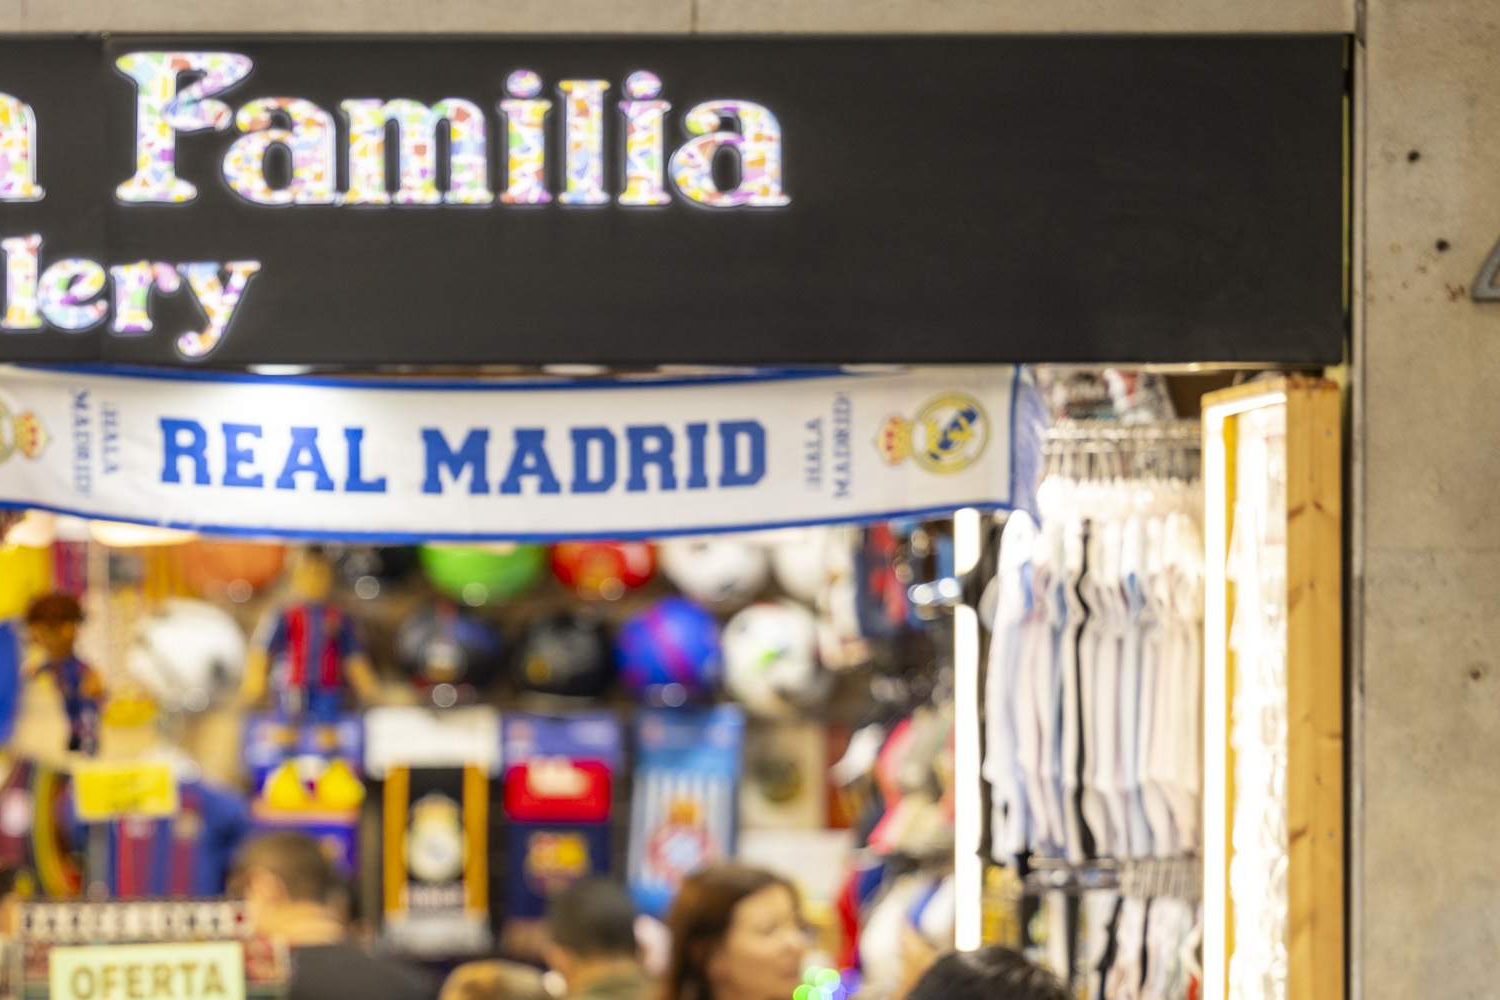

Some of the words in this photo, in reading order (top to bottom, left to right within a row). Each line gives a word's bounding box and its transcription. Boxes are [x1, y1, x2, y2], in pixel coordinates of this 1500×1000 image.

[115, 50, 790, 208] Familia
[158, 417, 387, 493] REAL
[421, 420, 767, 494] MADRID
[69, 960, 227, 1000] OFERTA
